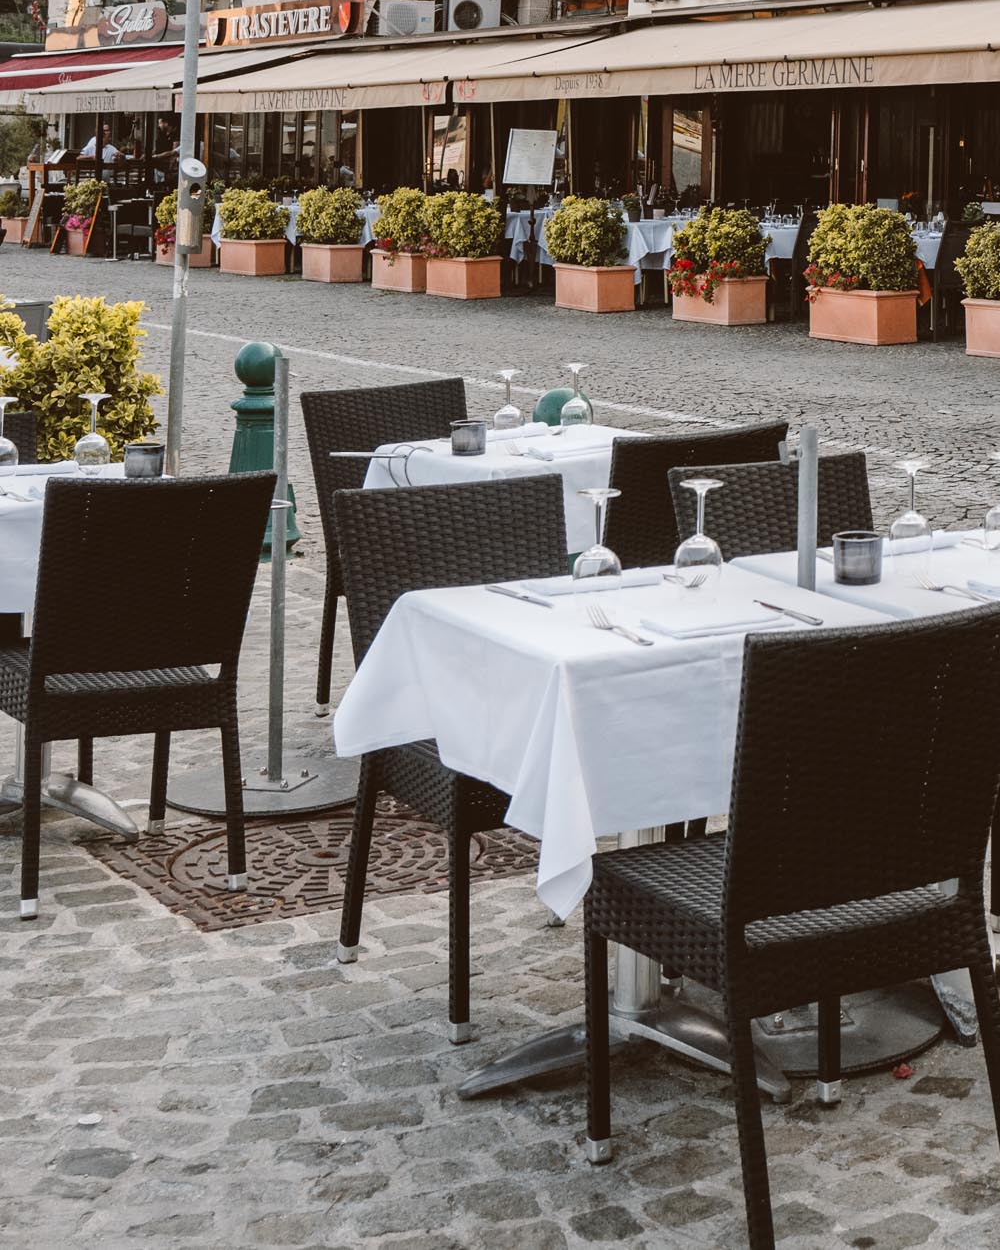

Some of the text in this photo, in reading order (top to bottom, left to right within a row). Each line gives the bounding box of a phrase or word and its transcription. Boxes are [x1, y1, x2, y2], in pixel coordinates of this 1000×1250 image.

[230, 5, 331, 41] TRASTEVERE
[554, 76, 580, 94] Depuis
[694, 55, 874, 90] LA MERE GERMAINE
[254, 87, 347, 111] LA MERE GERMAINE
